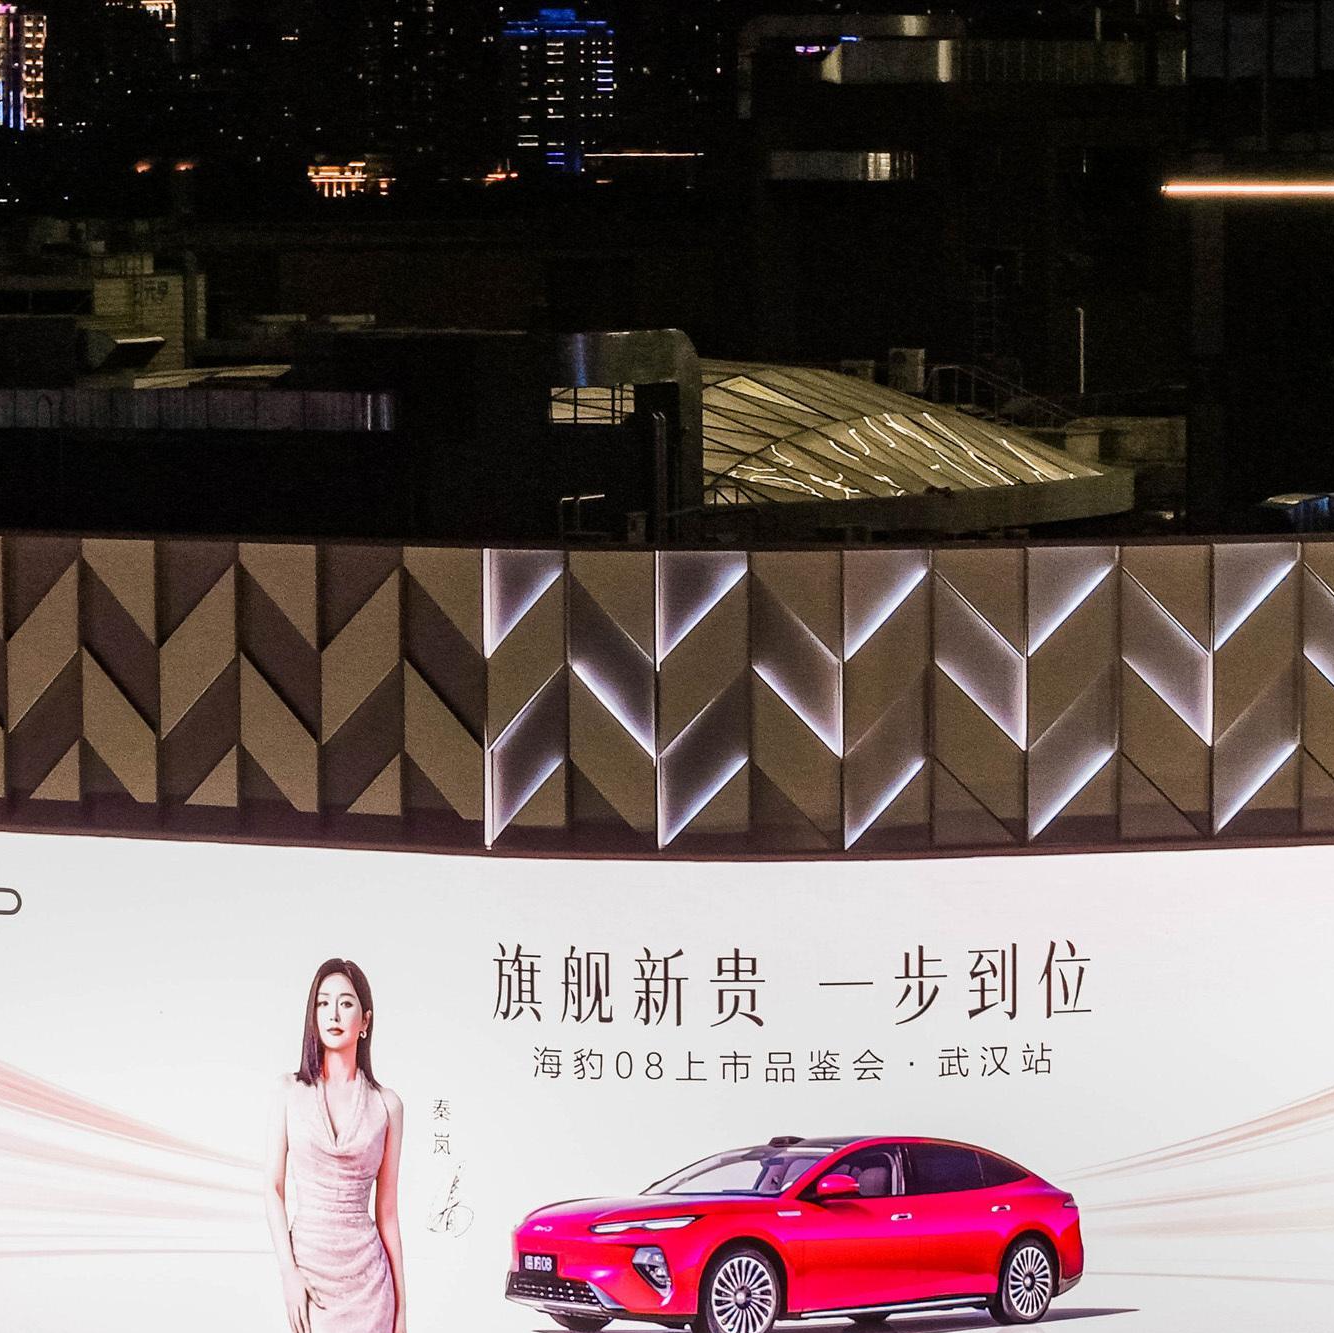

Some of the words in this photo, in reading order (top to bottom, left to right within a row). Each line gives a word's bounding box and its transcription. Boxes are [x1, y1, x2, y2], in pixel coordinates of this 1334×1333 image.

[492, 942, 766, 1028] 旗舰新贵
[818, 939, 1092, 1026] 一步到位
[433, 1099, 451, 1155] 秦岚
